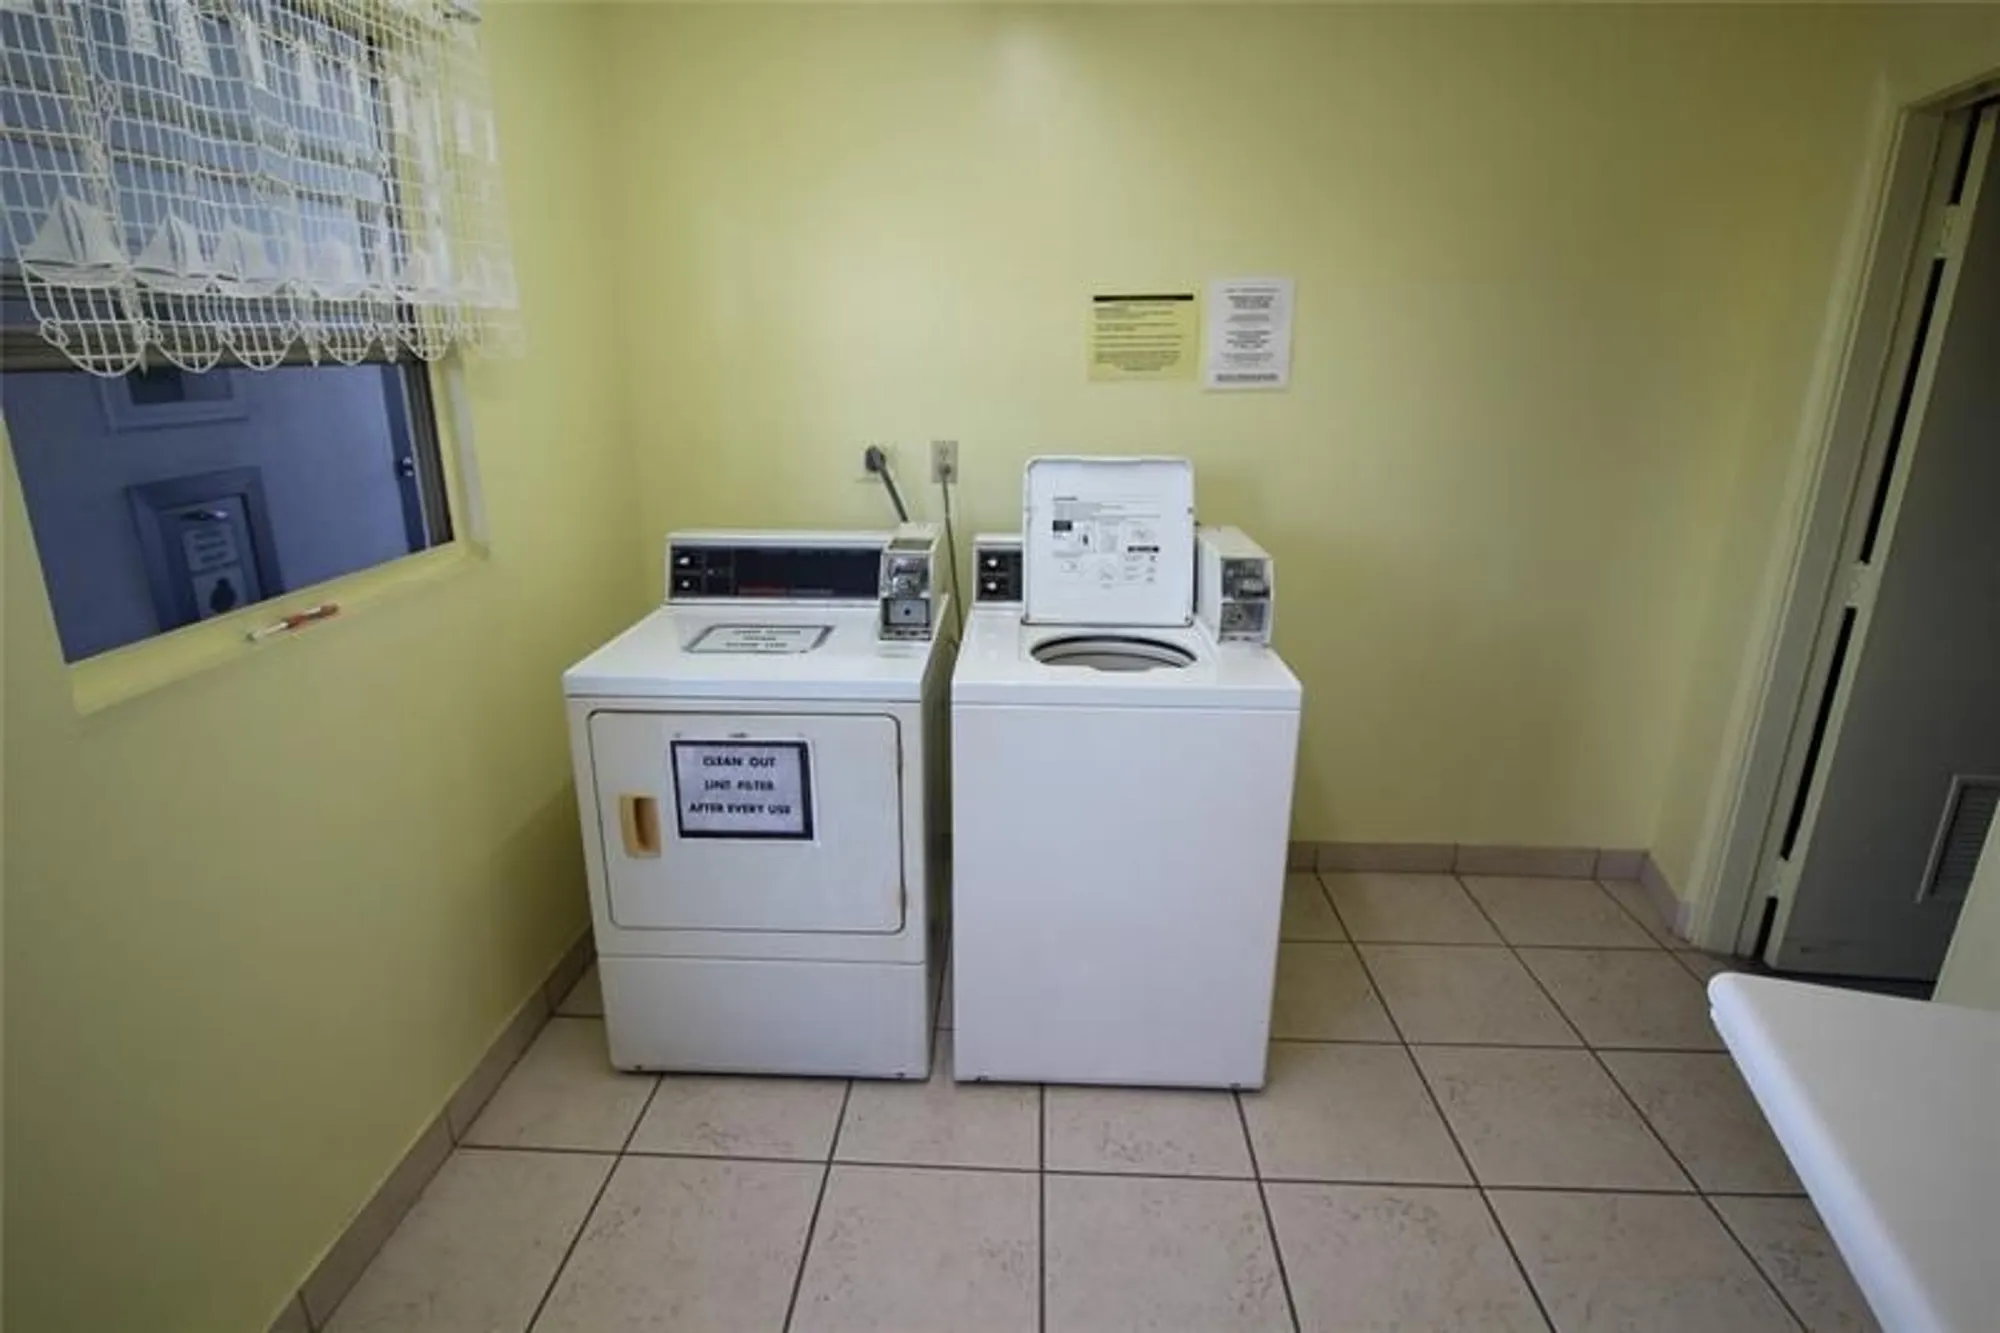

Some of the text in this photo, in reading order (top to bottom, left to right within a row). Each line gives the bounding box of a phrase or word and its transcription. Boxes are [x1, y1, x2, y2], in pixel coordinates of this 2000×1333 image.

[703, 757, 776, 768] CLEAN OUT
[705, 780, 774, 791] LINT FILTER
[689, 803, 791, 815] AFTER EVERY USE
